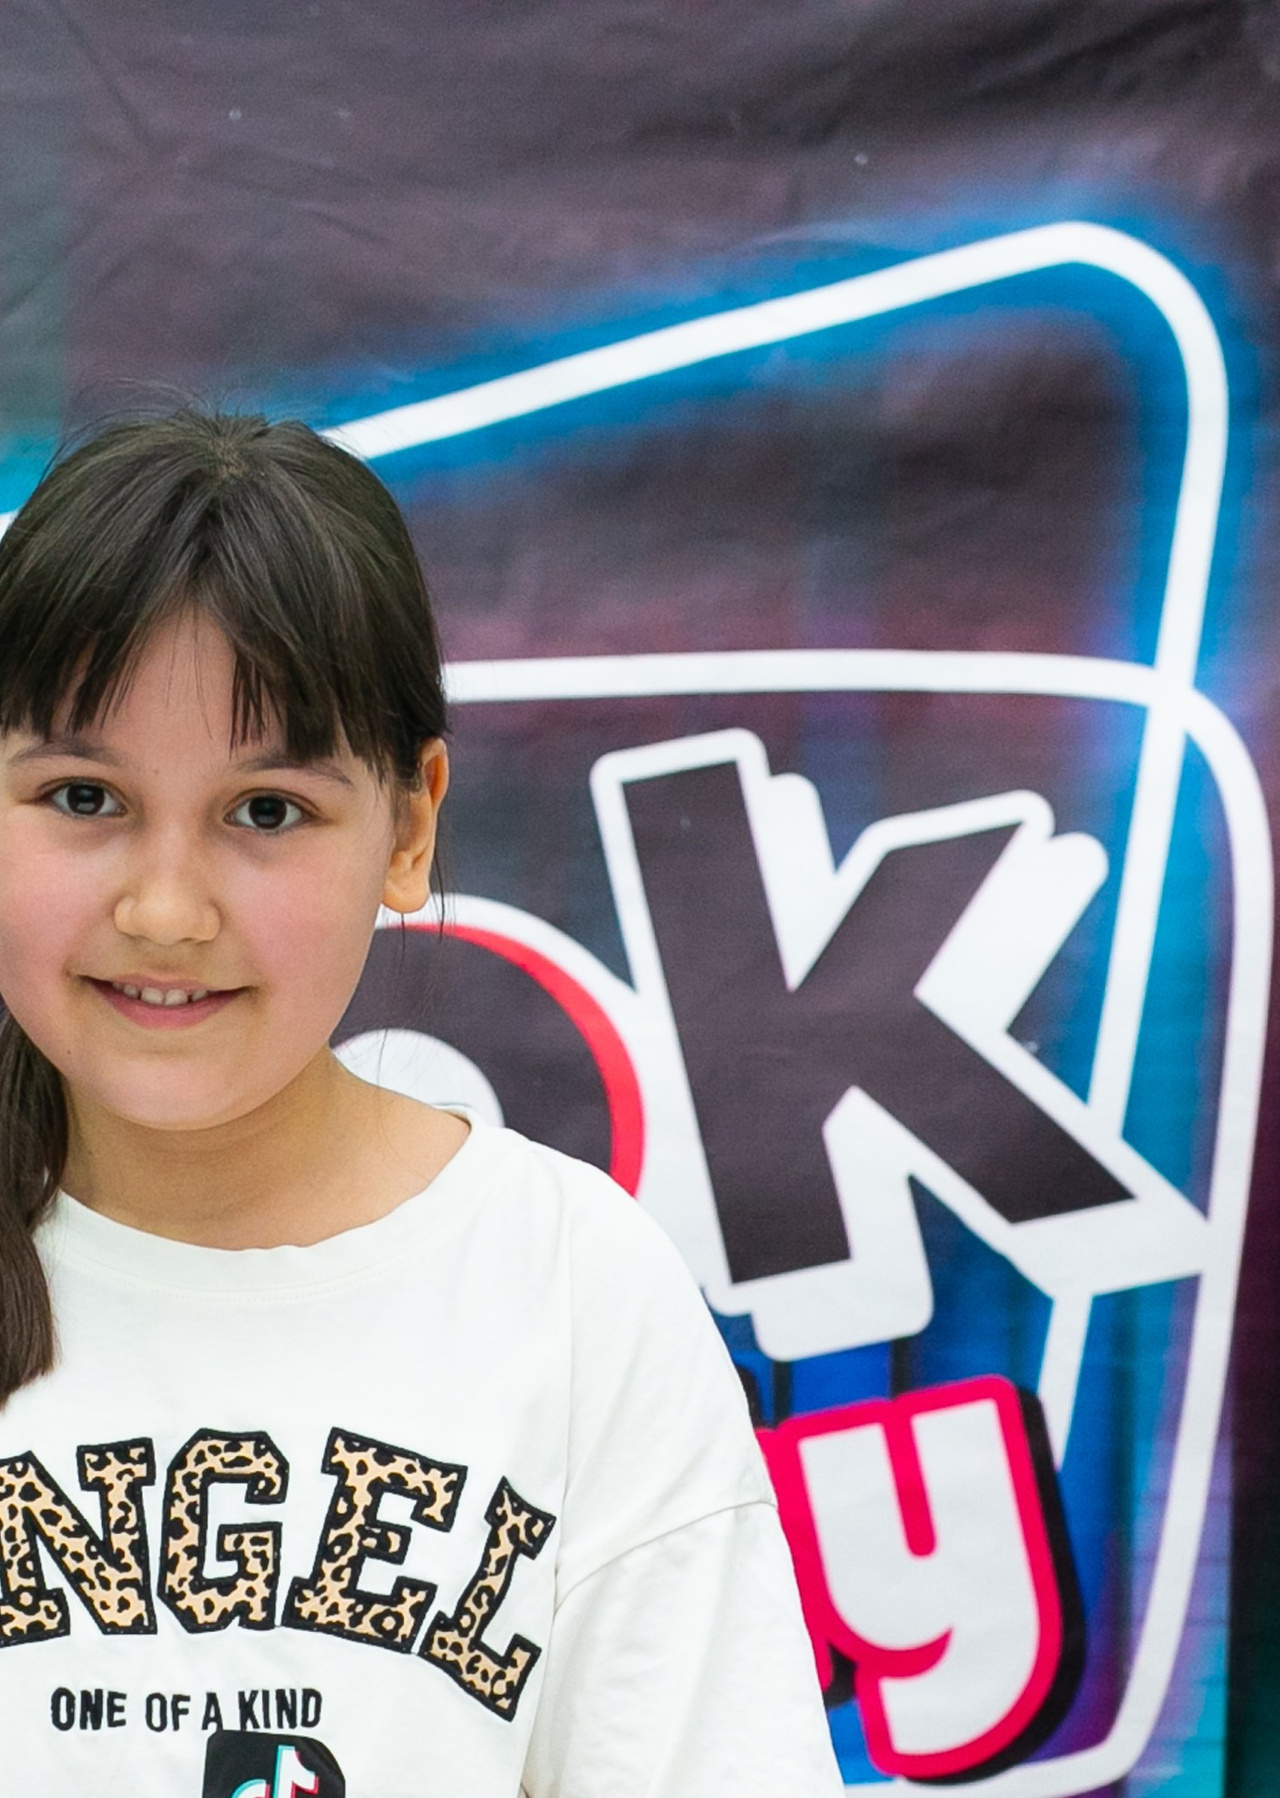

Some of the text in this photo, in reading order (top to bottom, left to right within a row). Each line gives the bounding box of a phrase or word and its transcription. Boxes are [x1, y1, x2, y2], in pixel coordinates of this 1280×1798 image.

[50, 1686, 323, 1732] ONE OF A KIND
